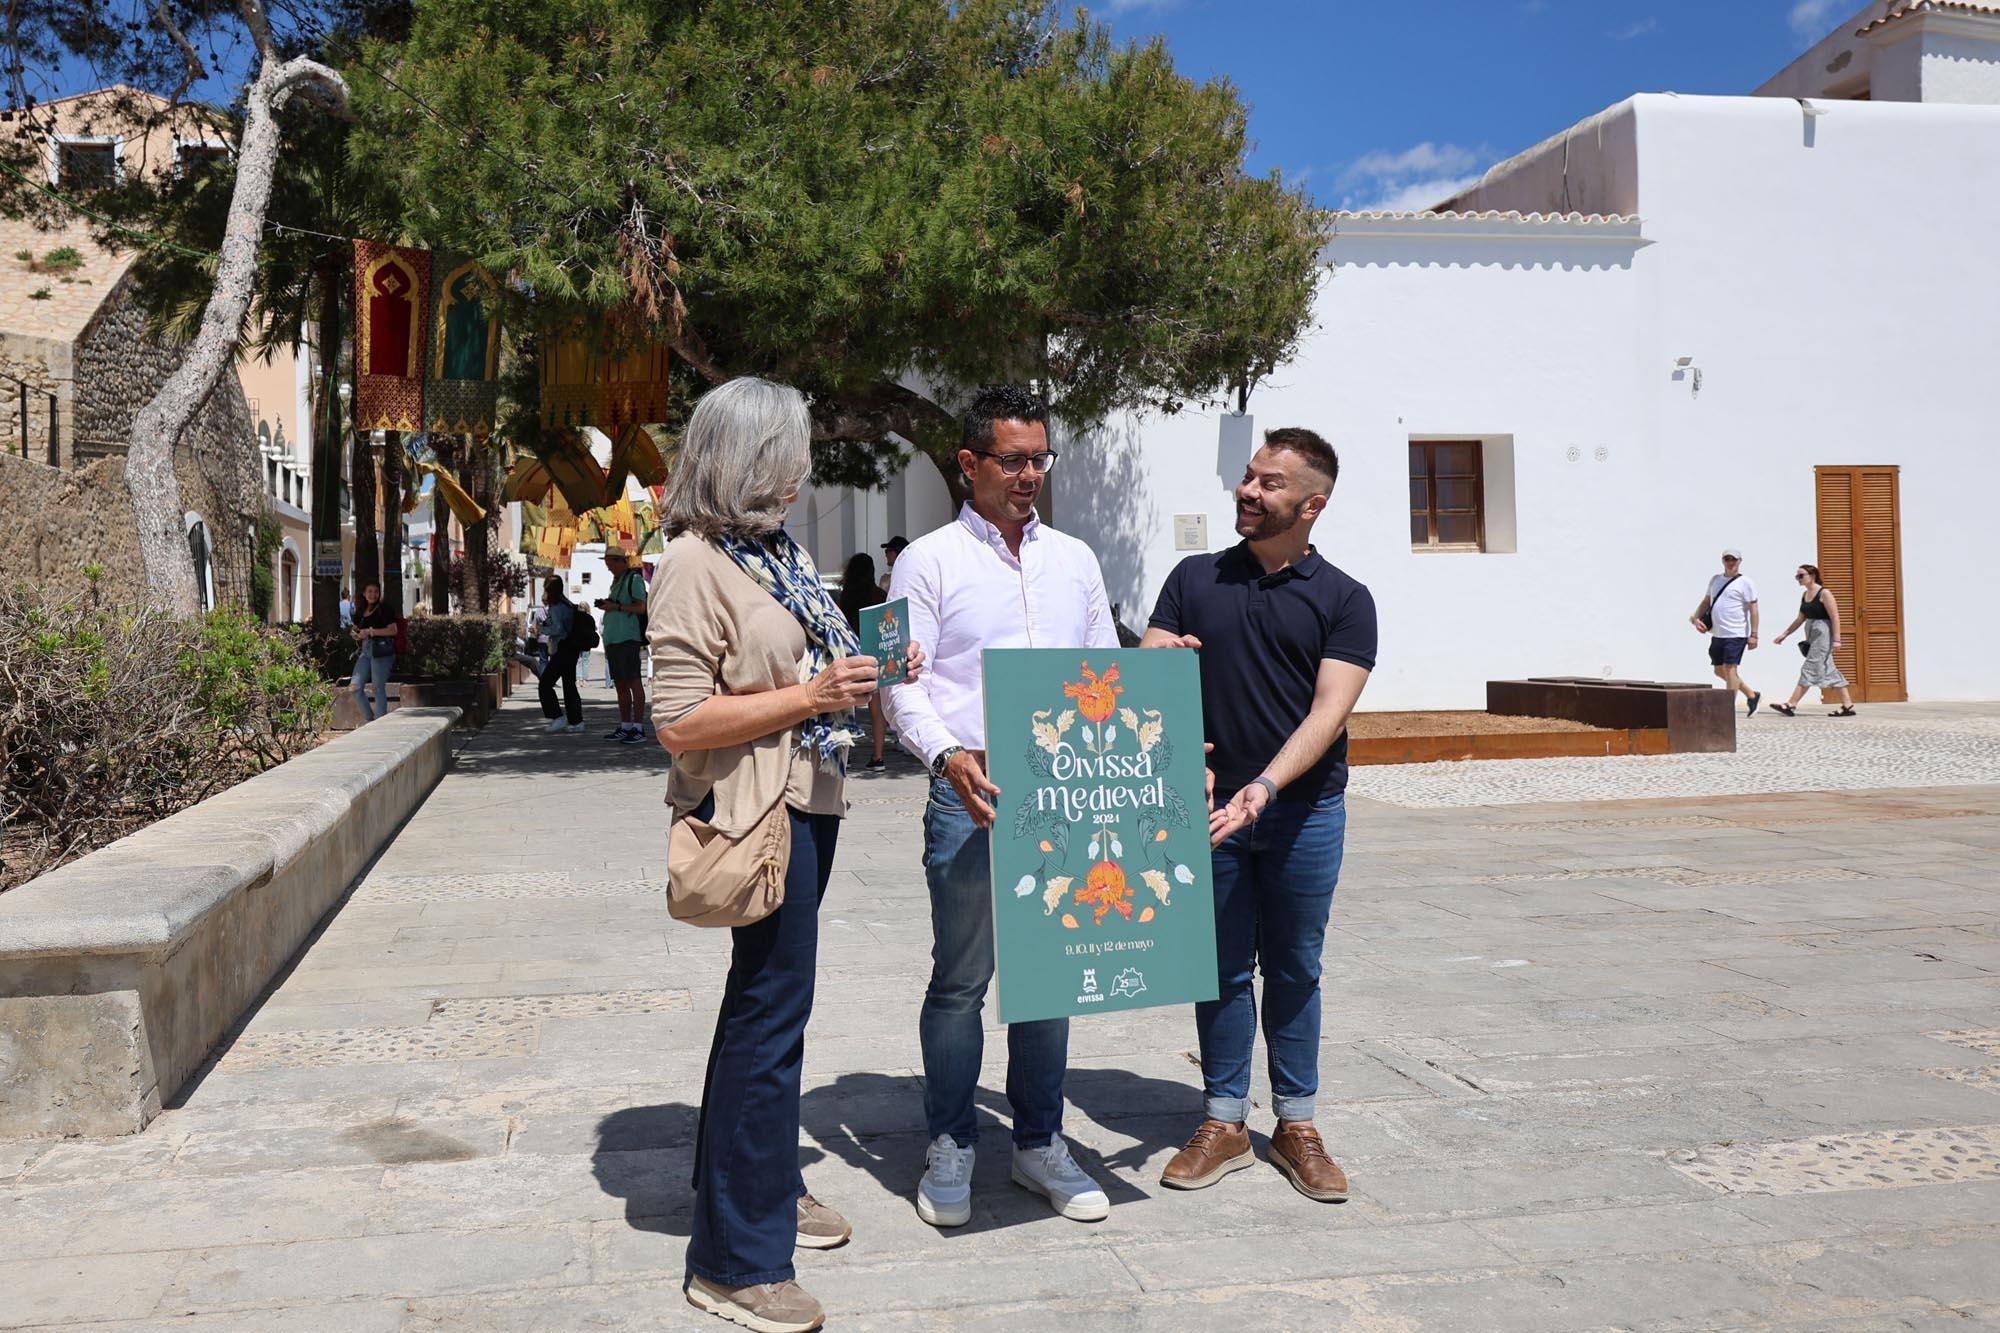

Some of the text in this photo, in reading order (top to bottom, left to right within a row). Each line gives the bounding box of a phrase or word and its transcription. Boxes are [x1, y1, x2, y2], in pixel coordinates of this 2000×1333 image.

[1095, 943, 1103, 956] y
[1103, 940, 1114, 952] 12
[1114, 940, 1127, 951] de
[1127, 939, 1154, 952] mayo
